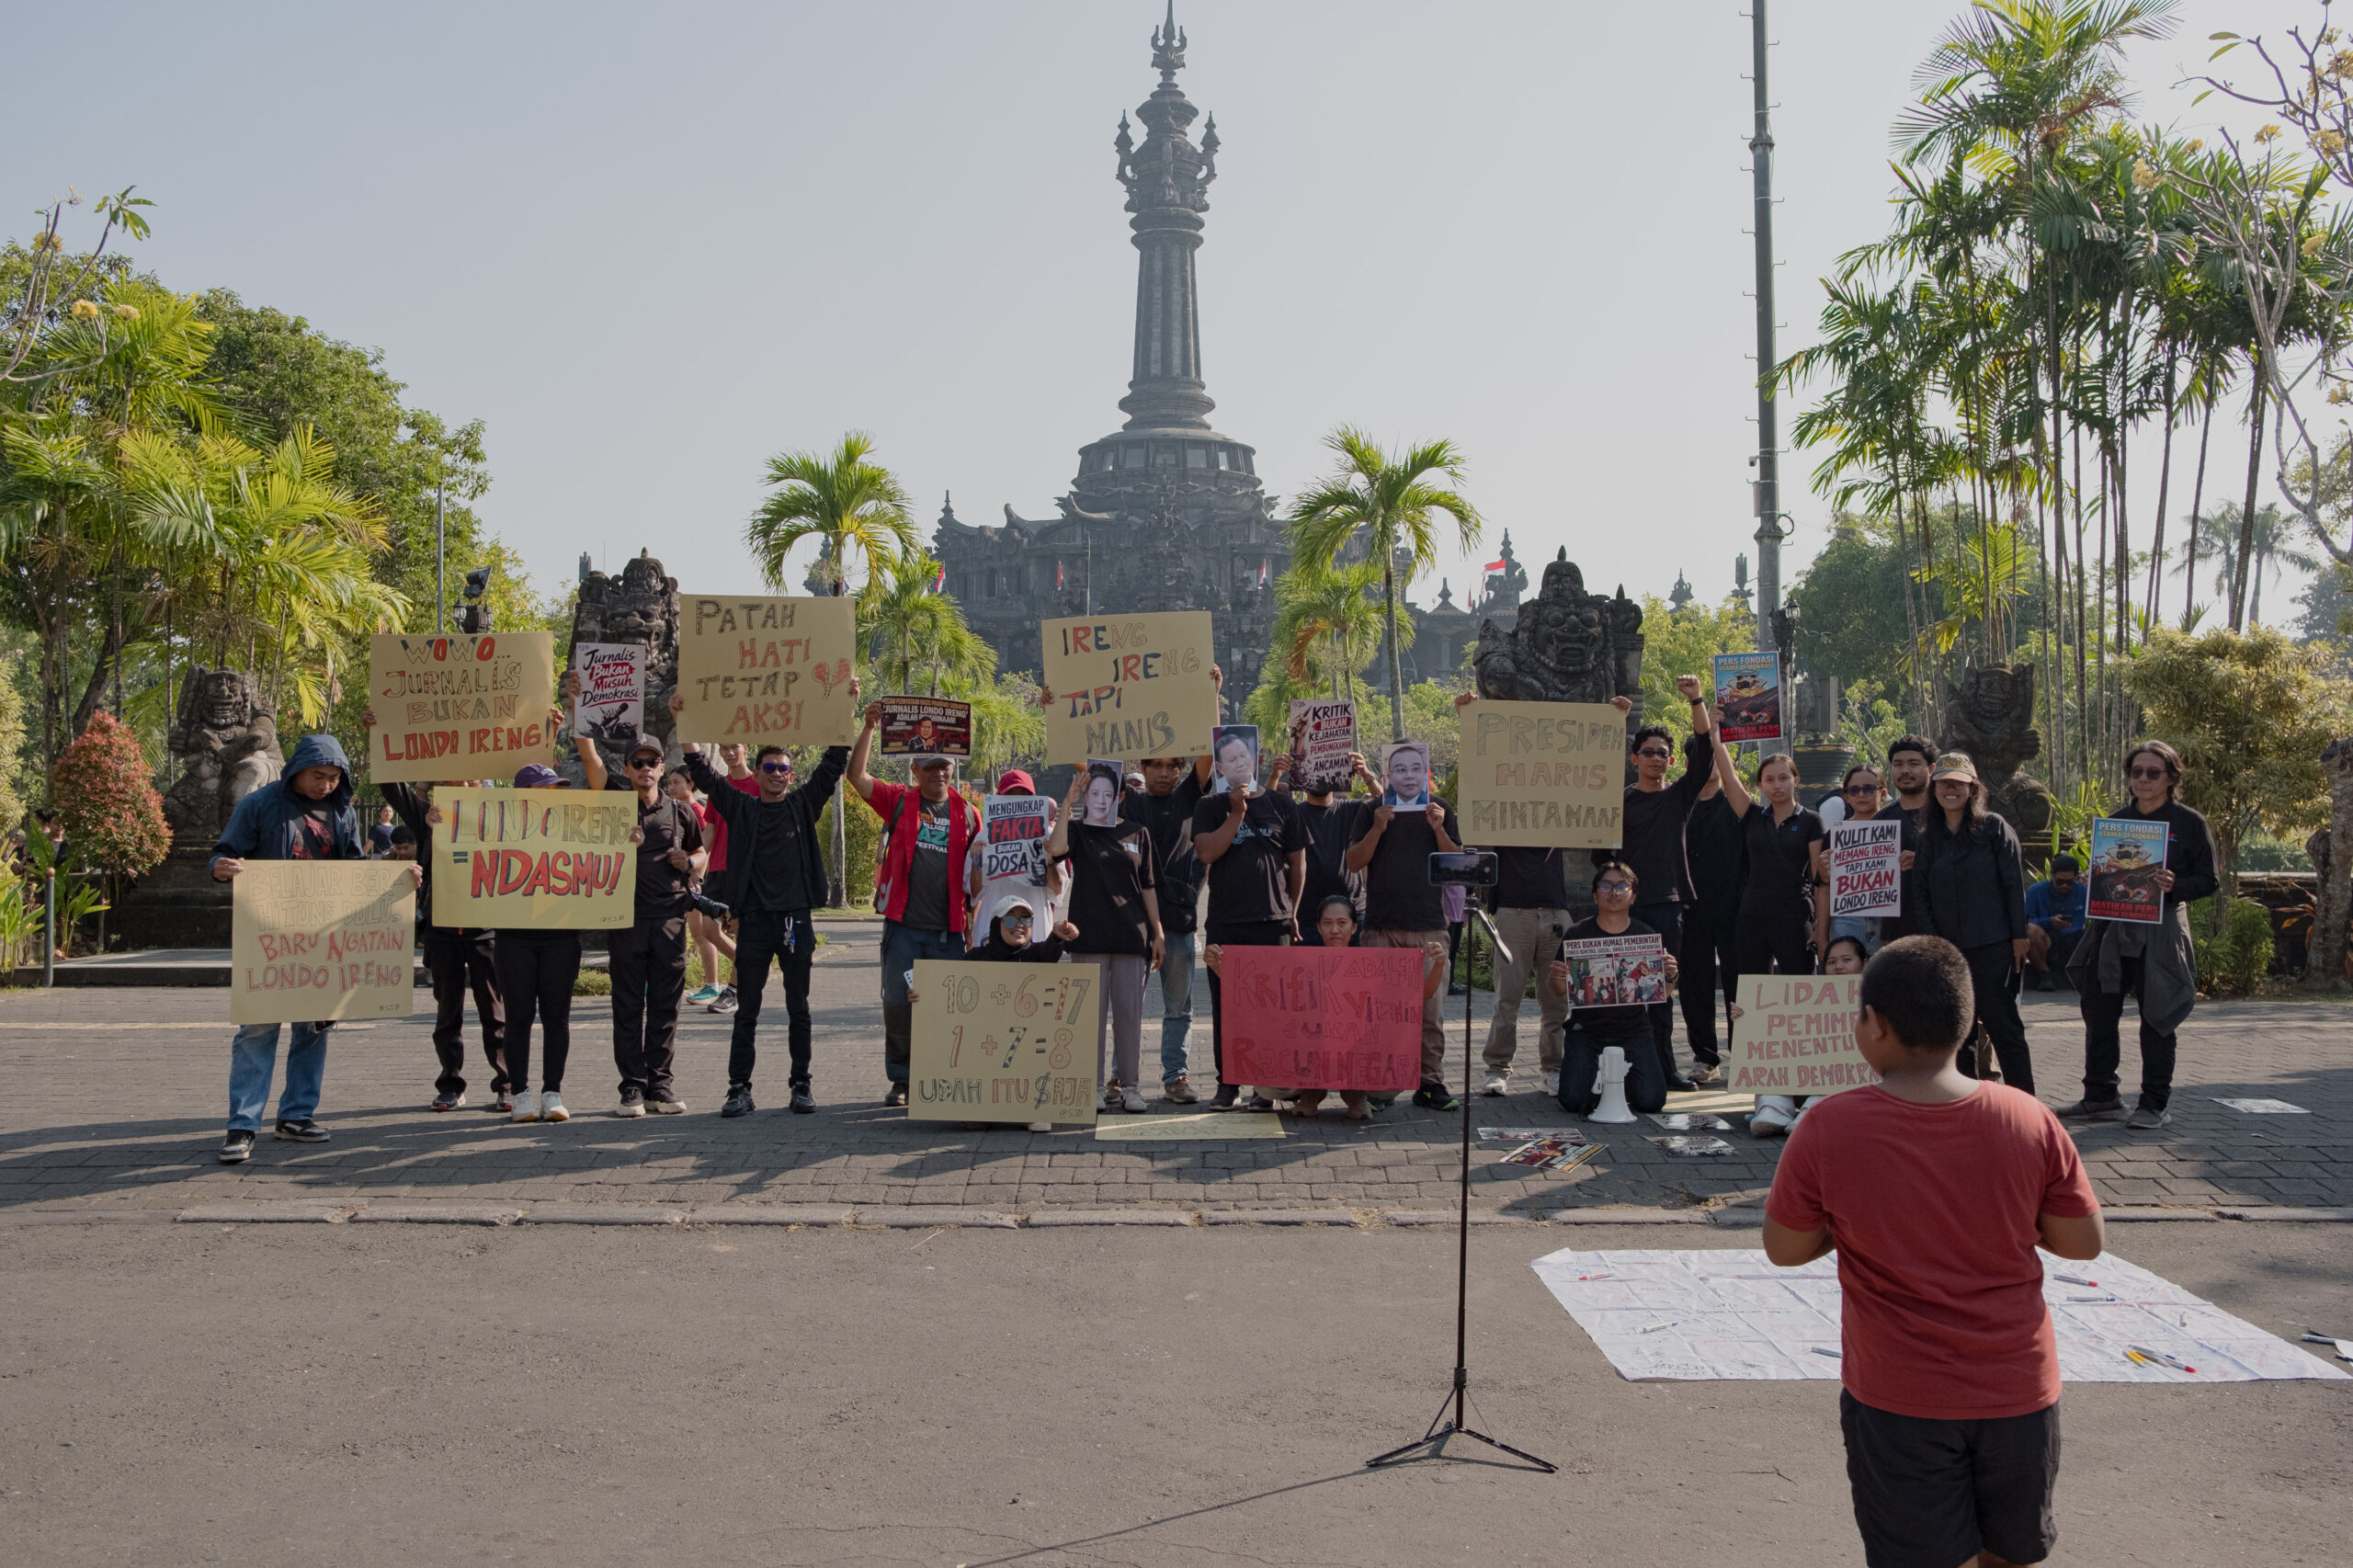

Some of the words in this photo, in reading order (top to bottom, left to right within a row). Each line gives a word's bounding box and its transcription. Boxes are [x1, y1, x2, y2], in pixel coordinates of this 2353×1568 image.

[696, 599, 797, 635] PATAH
[1063, 622, 1147, 656] IRENG
[583, 647, 636, 671] Jurnalis
[738, 636, 811, 669] HATI
[1113, 647, 1200, 683] IRENG
[1719, 657, 1738, 665] PERS
[1740, 654, 1774, 665] FONDASI
[593, 664, 631, 679] Bukan
[593, 675, 635, 692] Musuh
[580, 688, 639, 707] Demokrasi
[696, 671, 801, 701] TETAP
[407, 695, 518, 724] BUKAN
[920, 705, 944, 716] LONDO
[1060, 685, 1122, 719] TAPI
[1313, 703, 1351, 722] KRITIK
[723, 699, 804, 735] AKSI
[896, 713, 918, 722] ADALAH
[1321, 718, 1347, 731] BUKAN
[383, 730, 460, 761] LONDO
[1086, 710, 1176, 756] MANIS
[1477, 712, 1624, 756] PRESIDEN
[1310, 740, 1352, 756] PEMBUNGKAMAN
[1495, 762, 1608, 790] HARUS
[988, 800, 1044, 816] MENGUNGKAP
[451, 799, 561, 844] LONDO
[561, 803, 631, 846] IRENG
[923, 821, 946, 832] VILLAGE
[991, 816, 1042, 844] FAKTA
[2098, 822, 2121, 832] PERS
[2124, 824, 2163, 835] FONDASI
[997, 843, 1020, 853] BUKAN
[1834, 827, 1869, 848] KULIT
[1870, 824, 1897, 842] KAMI
[986, 852, 1029, 877] DOSA
[1834, 846, 1870, 863] MEMANG
[1845, 862, 1863, 873] TAPI
[1865, 859, 1887, 869] KAMI
[246, 862, 343, 903] BELAJAR
[1836, 869, 1895, 896] BUKAN
[1833, 893, 1867, 913] LONDO
[1868, 890, 1898, 906] IRENG
[2090, 900, 2133, 913] MATIKAN
[2134, 904, 2159, 913] PERS
[258, 932, 319, 962] BARU
[1582, 939, 1602, 949] BUKAN
[1602, 937, 1623, 948] HUMAS
[245, 962, 329, 993] LONDO
[338, 961, 403, 994] IRENG
[942, 974, 980, 1015] 10
[1014, 973, 1039, 1018] 6
[1283, 1018, 1381, 1045] BUKAN
[1768, 1011, 1860, 1037] PEMIMP
[950, 1026, 963, 1068] 1
[1003, 1027, 1028, 1068] 7
[1049, 1028, 1074, 1070] 8
[1746, 1034, 1855, 1060] MENENTU
[1734, 1066, 1789, 1087] ARAH
[1796, 1062, 1881, 1088] DEMOKRA
[919, 1077, 982, 1104] UDAH
[992, 1078, 1029, 1104] ITU
